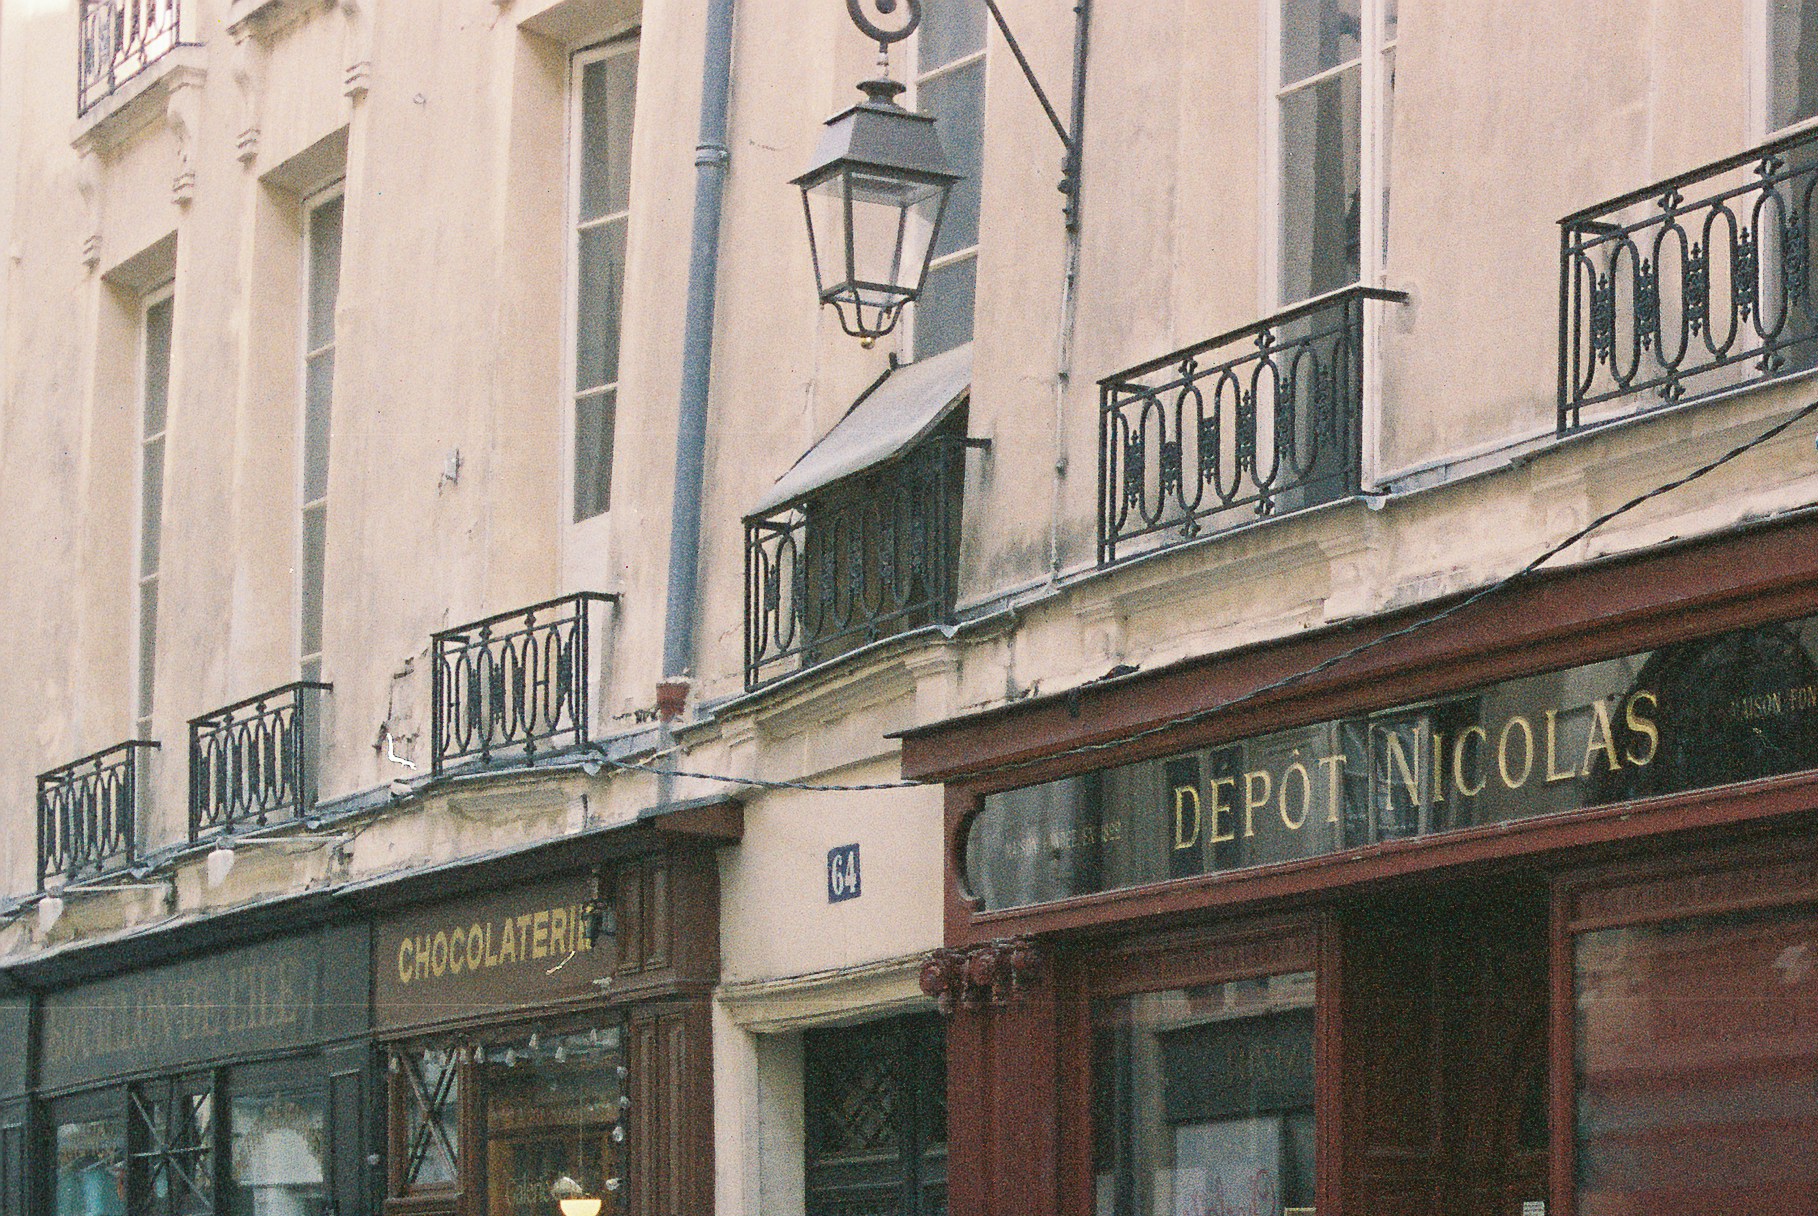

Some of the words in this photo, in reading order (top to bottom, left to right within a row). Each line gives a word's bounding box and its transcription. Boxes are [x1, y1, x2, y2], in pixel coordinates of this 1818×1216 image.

[1173, 747, 1347, 850] DÉPÔT
[1386, 689, 1660, 812] NICOLAS
[831, 849, 860, 898] 64
